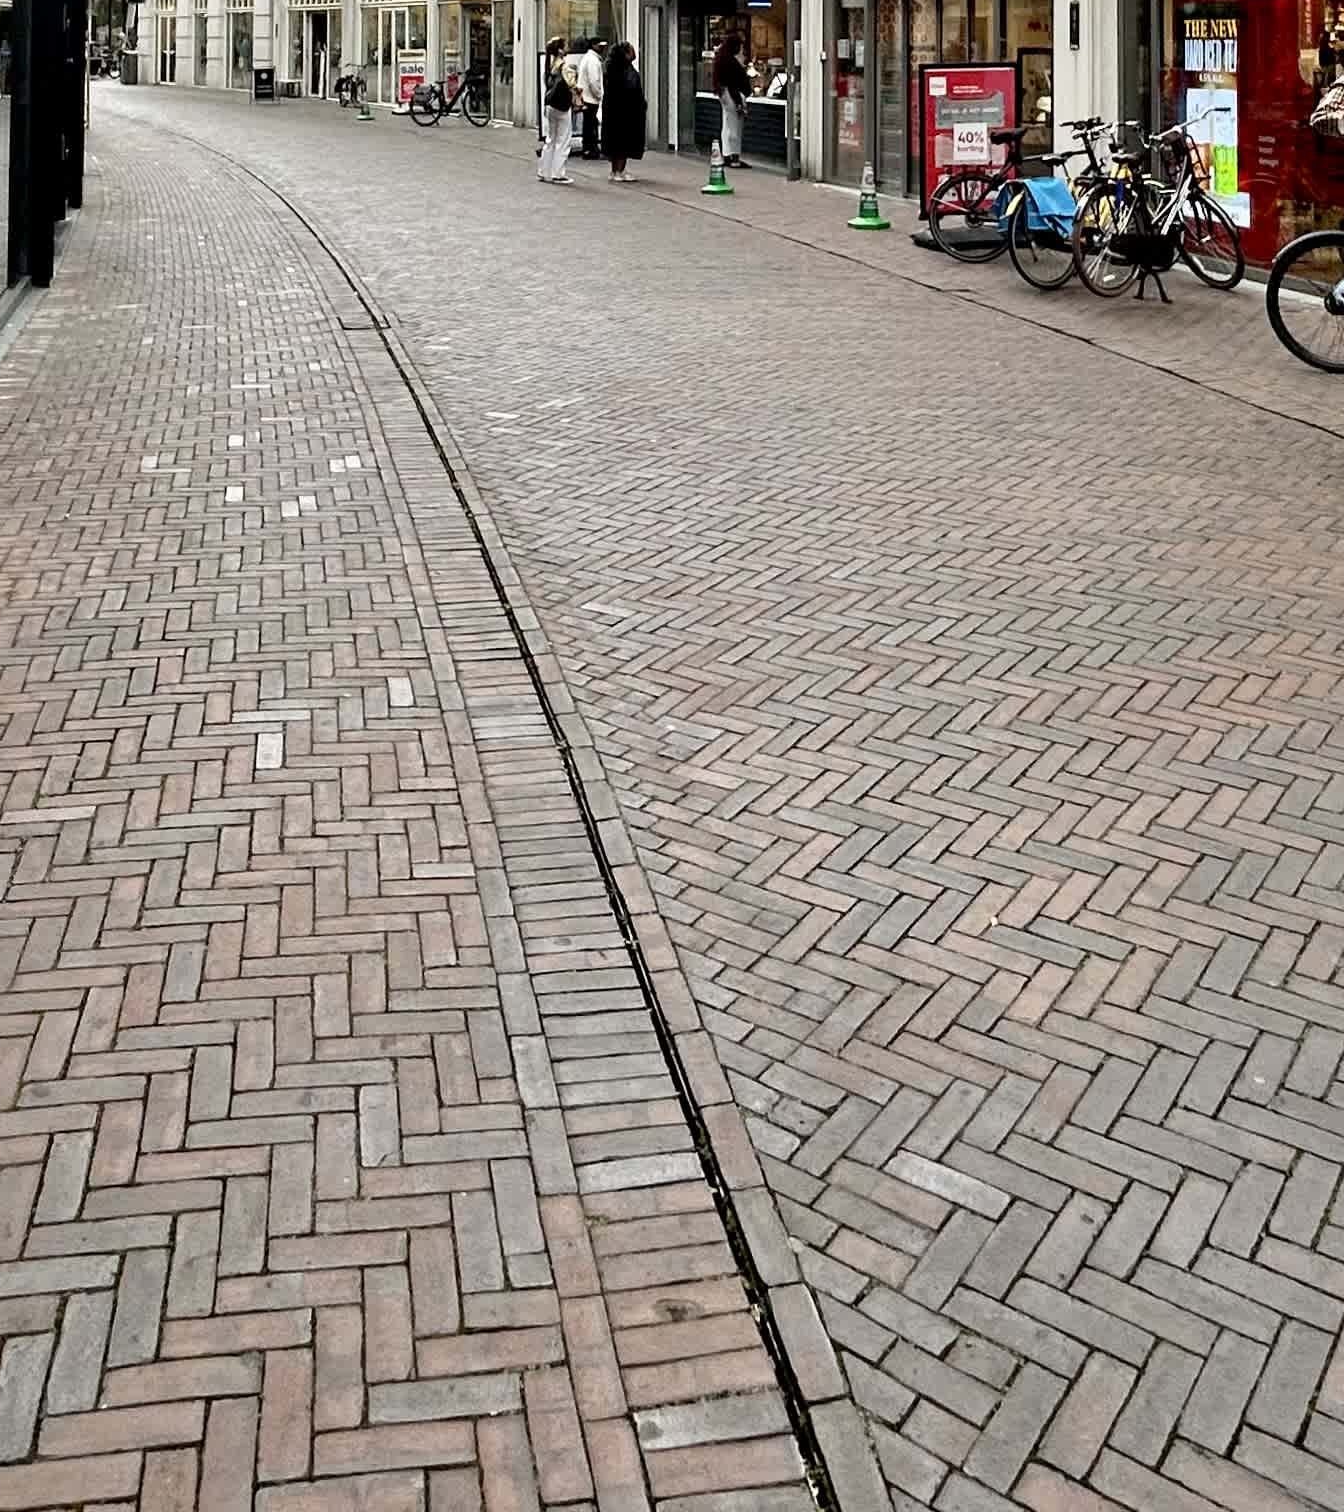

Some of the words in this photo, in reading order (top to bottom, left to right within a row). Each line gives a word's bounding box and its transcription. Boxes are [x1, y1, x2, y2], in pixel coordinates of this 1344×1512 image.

[1184, 19, 1208, 38] THE
[1210, 18, 1237, 38] NEW
[400, 63, 424, 74] sale
[958, 130, 984, 144] 40%
